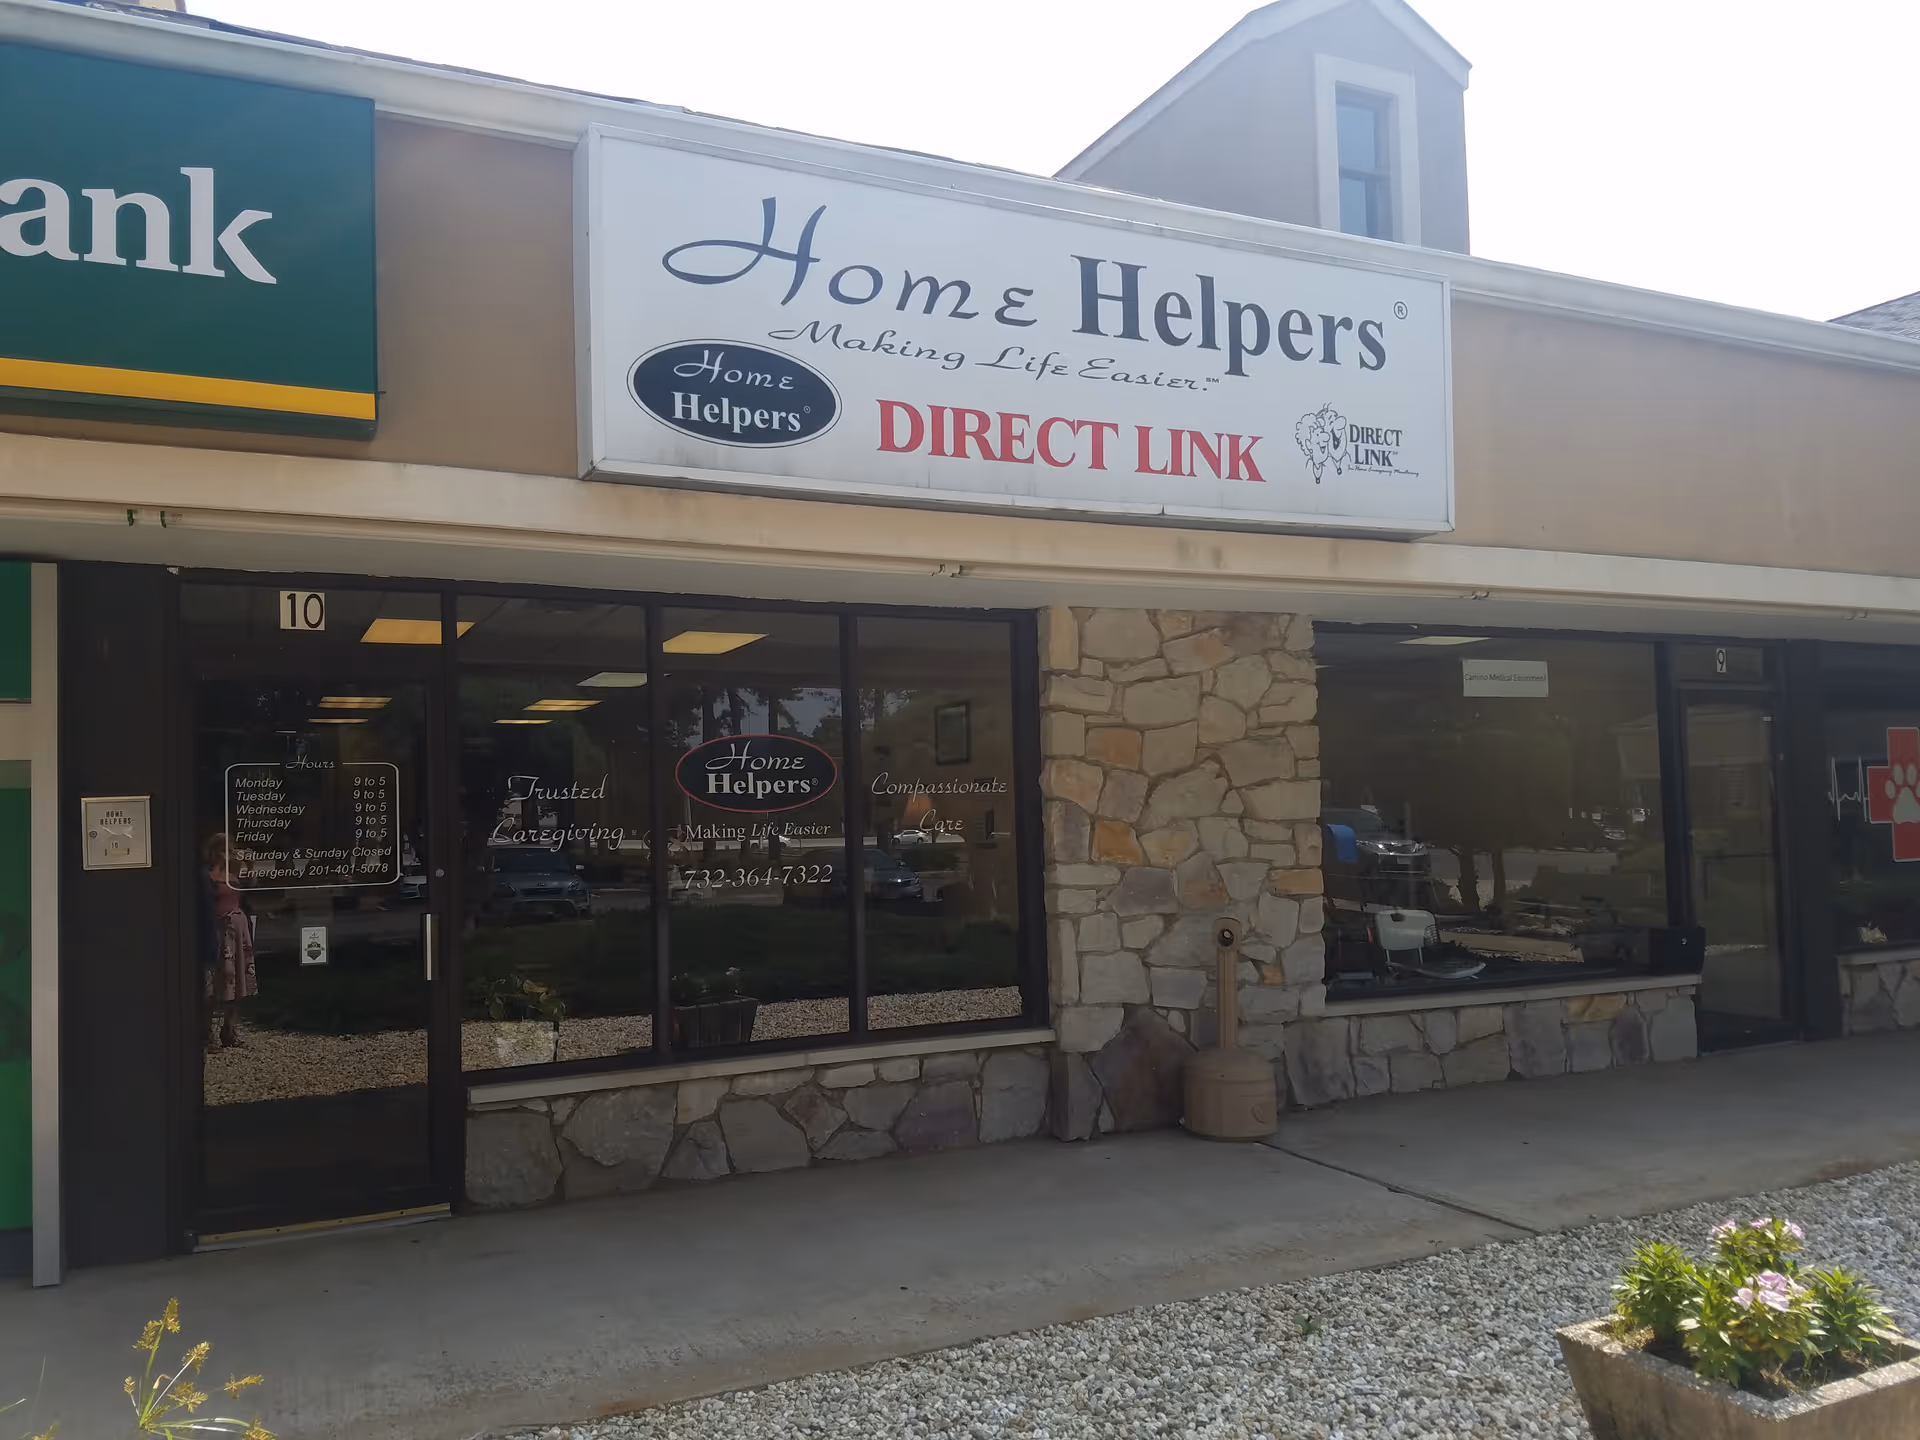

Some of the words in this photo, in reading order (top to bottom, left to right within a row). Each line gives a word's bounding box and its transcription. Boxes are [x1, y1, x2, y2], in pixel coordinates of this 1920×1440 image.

[0, 166, 277, 284] ank
[662, 197, 1038, 327] Home
[1070, 254, 1386, 377] Helpers
[767, 320, 965, 370] Making
[974, 346, 1068, 381] Life
[673, 350, 794, 390] Home
[876, 399, 1119, 470] DIRECT
[1134, 424, 1266, 482] LINK
[1349, 423, 1402, 447] DIRECT
[287, 593, 323, 629] 10
[1717, 649, 1725, 672] 9
[285, 754, 335, 769] Hours
[705, 740, 806, 770] Home
[235, 778, 283, 790] Monday
[354, 776, 361, 786] 9
[364, 777, 375, 786] to
[378, 777, 386, 786] 5
[507, 773, 609, 800] Trusted
[871, 771, 1008, 803] Compassionate
[236, 791, 286, 804] Tuesday
[353, 790, 360, 800] 9
[363, 790, 374, 799] to
[378, 789, 385, 799] 5
[105, 810, 124, 818] HOME
[236, 804, 306, 817] Wednesday
[355, 803, 362, 812] 9
[365, 803, 376, 812] to
[379, 802, 387, 812] 5
[919, 808, 964, 831] Care
[236, 818, 292, 831] Thursday
[355, 816, 362, 825] 9
[365, 816, 376, 825] to
[379, 815, 387, 825] 5
[492, 817, 624, 852] Caregiving
[685, 824, 746, 842] Making
[751, 822, 779, 837] Life
[784, 822, 831, 836] Easier
[111, 841, 119, 849] 10
[235, 831, 274, 844] Friday
[355, 829, 362, 838] 9
[365, 829, 376, 838] to
[379, 828, 388, 838] 5
[236, 849, 289, 862] Saturday
[292, 849, 301, 859] &
[304, 848, 349, 861] Sunday
[352, 846, 392, 857] Closed
[238, 866, 306, 879] Emergency
[308, 863, 389, 876] 201-401-5078
[684, 864, 833, 889] 732-364-7322
